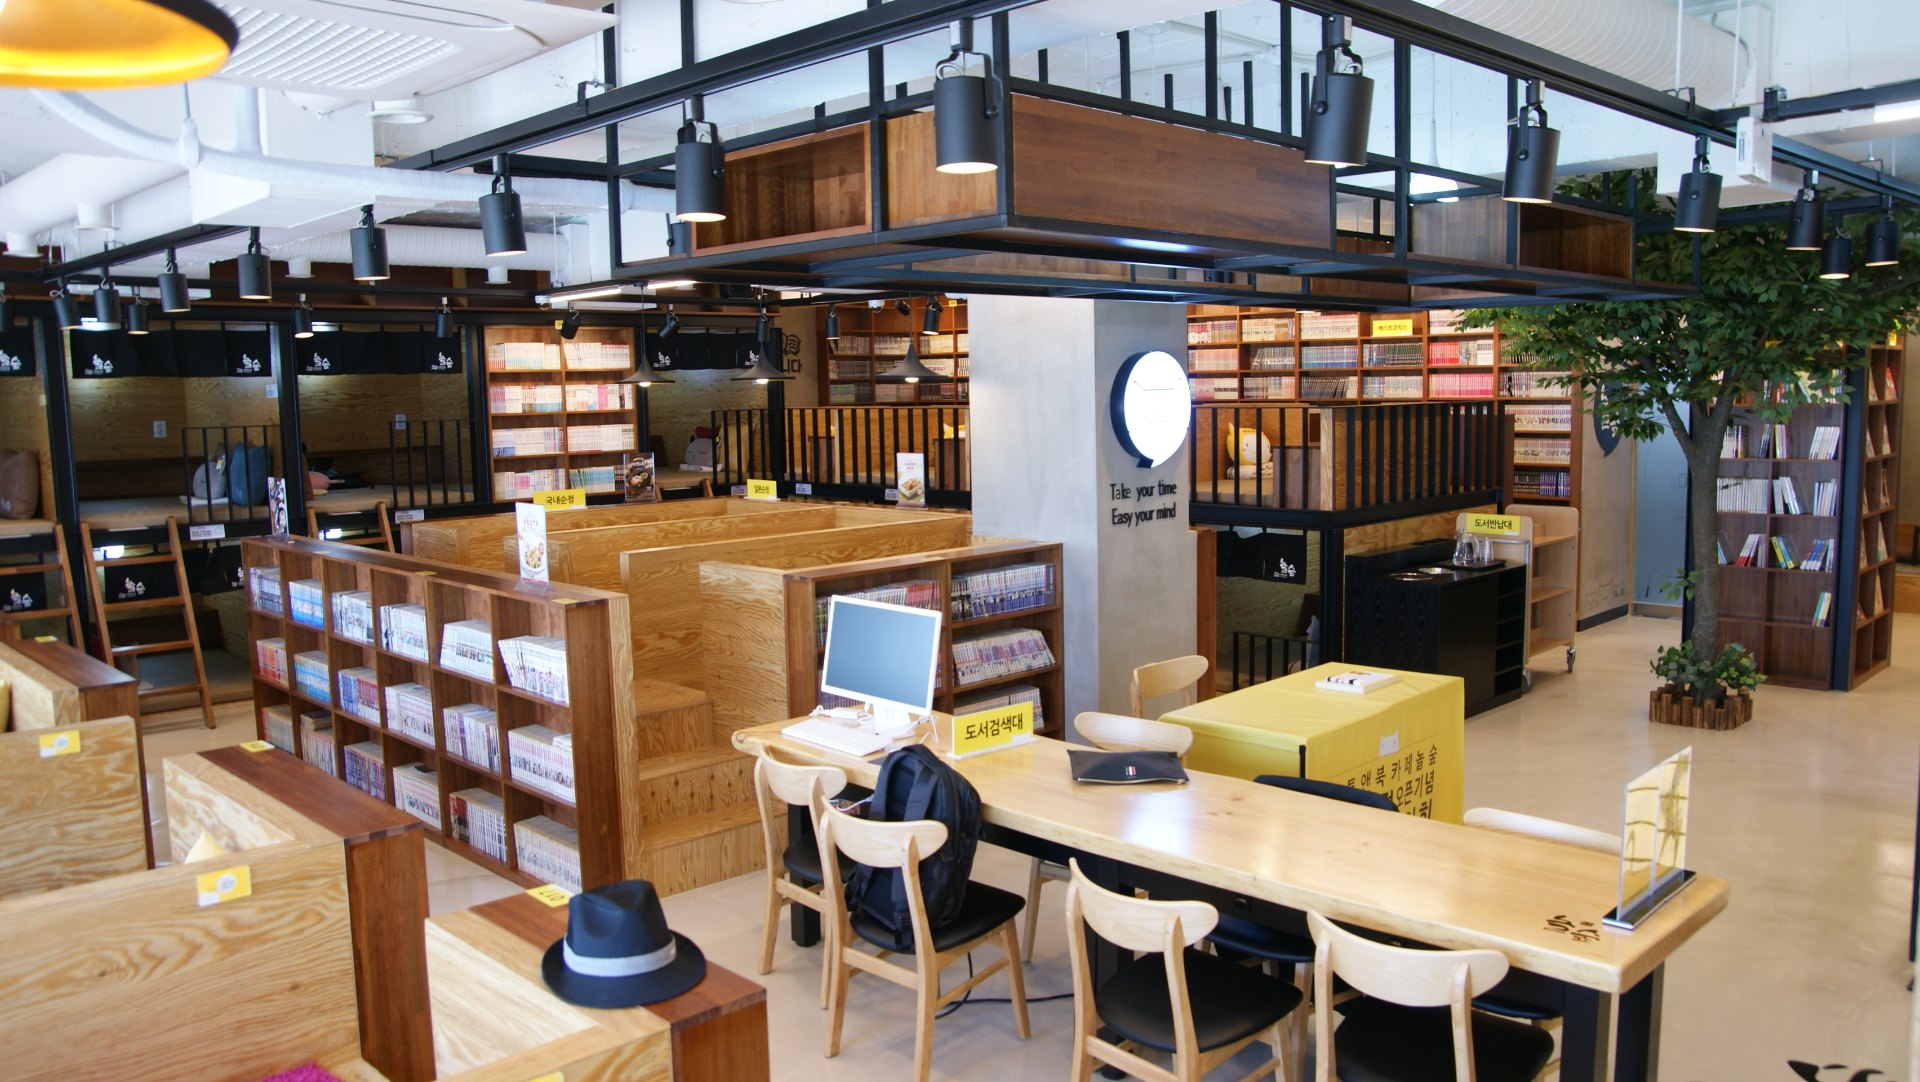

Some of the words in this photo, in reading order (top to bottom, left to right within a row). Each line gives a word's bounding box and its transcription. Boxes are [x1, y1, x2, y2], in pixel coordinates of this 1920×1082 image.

[546, 494, 574, 505] 국내순정
[1109, 483, 1131, 500] Take
[1136, 485, 1155, 502] your
[1158, 479, 1177, 496] time
[1112, 507, 1133, 527] Easy
[1134, 507, 1153, 527] your
[1156, 502, 1176, 520] mind
[1474, 518, 1512, 531] 도서반납대
[964, 712, 1023, 740] 도서검색대
